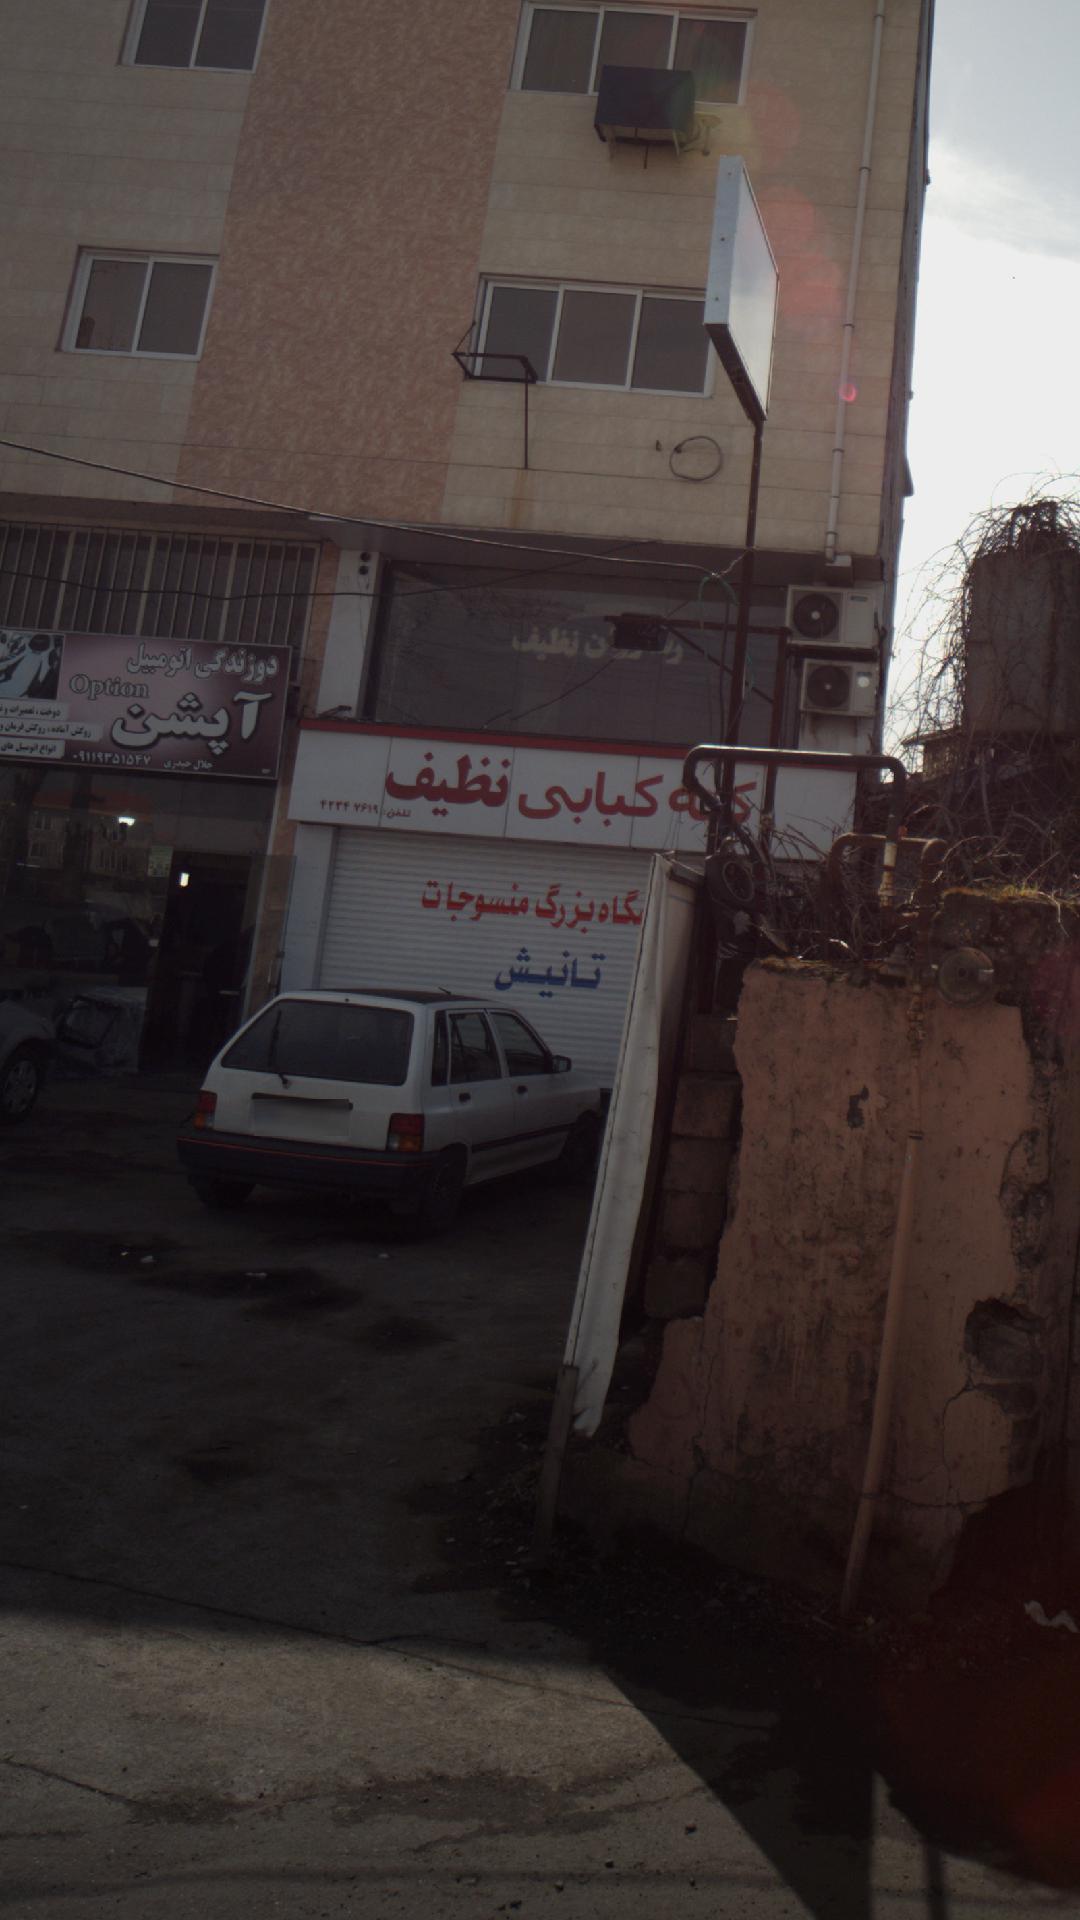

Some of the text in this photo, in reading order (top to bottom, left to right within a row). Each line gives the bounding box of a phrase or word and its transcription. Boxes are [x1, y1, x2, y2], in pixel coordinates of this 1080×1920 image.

[69, 673, 150, 700] Option
[127, 641, 279, 684] دوزندگی اتومبیل
[110, 691, 273, 757] آپشن
[385, 752, 510, 818] نظیف
[518, 771, 664, 827] کبابی
[421, 880, 529, 922] منسوجات
[535, 883, 594, 934] بزرگ
[494, 947, 606, 998] تانیش
